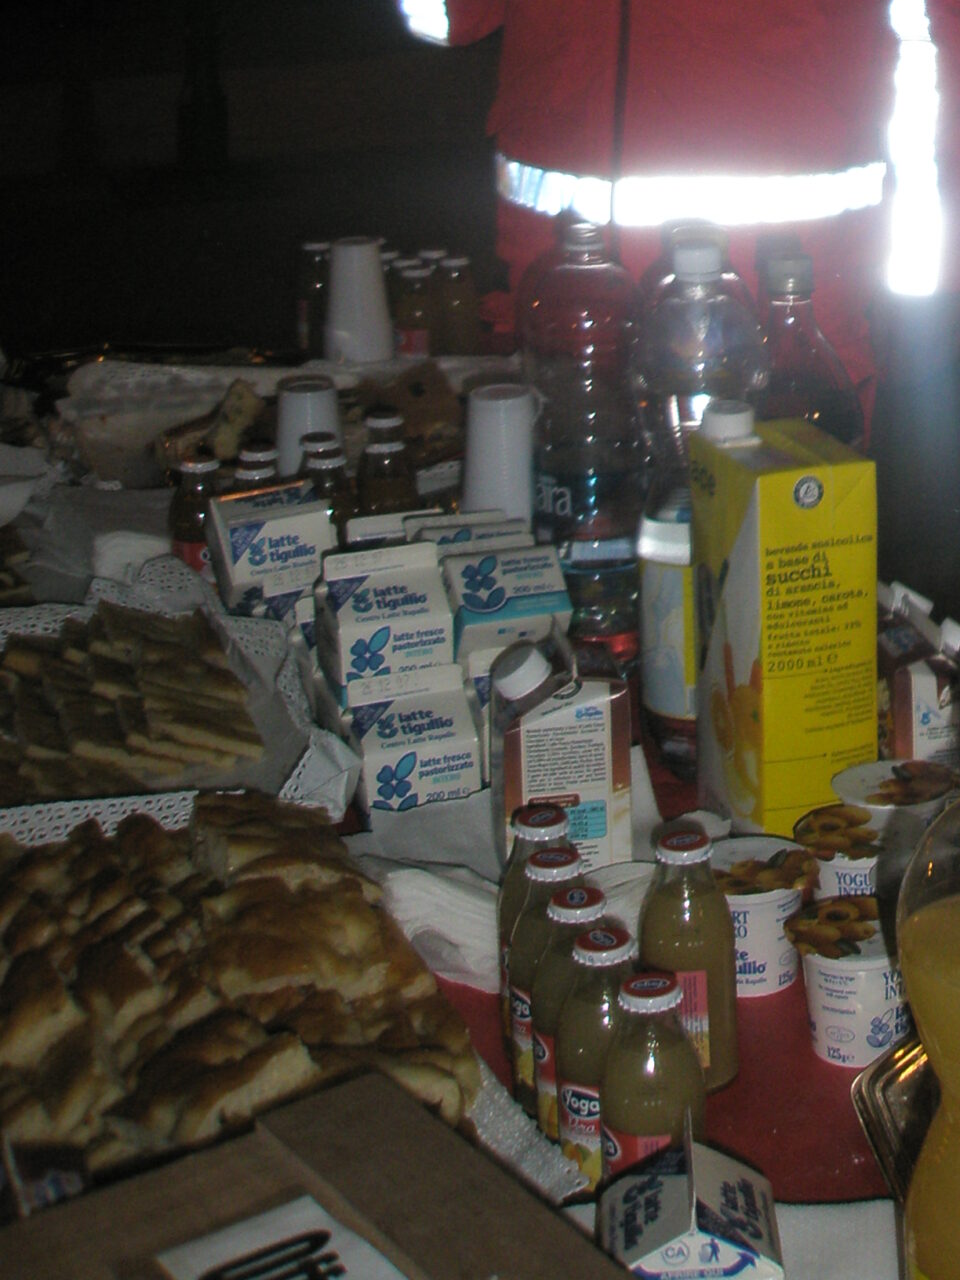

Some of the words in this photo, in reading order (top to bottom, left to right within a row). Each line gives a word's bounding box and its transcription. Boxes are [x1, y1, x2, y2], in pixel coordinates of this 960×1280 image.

[268, 534, 300, 549] latte
[269, 544, 317, 563] tigullio
[778, 555, 809, 568] base
[812, 550, 828, 562] di
[766, 561, 832, 585] succhi
[373, 584, 409, 598] latte
[766, 585, 780, 596] di
[375, 592, 428, 611] tigullio
[416, 627, 445, 640] fresco
[768, 657, 804, 673] 2000
[807, 656, 823, 668] ml
[399, 708, 433, 723] latte
[401, 717, 454, 736] tigullio
[420, 757, 442, 769] latte
[443, 751, 472, 764] fresco
[419, 760, 474, 780] pastorizzato
[563, 1089, 600, 1115] Yoga
